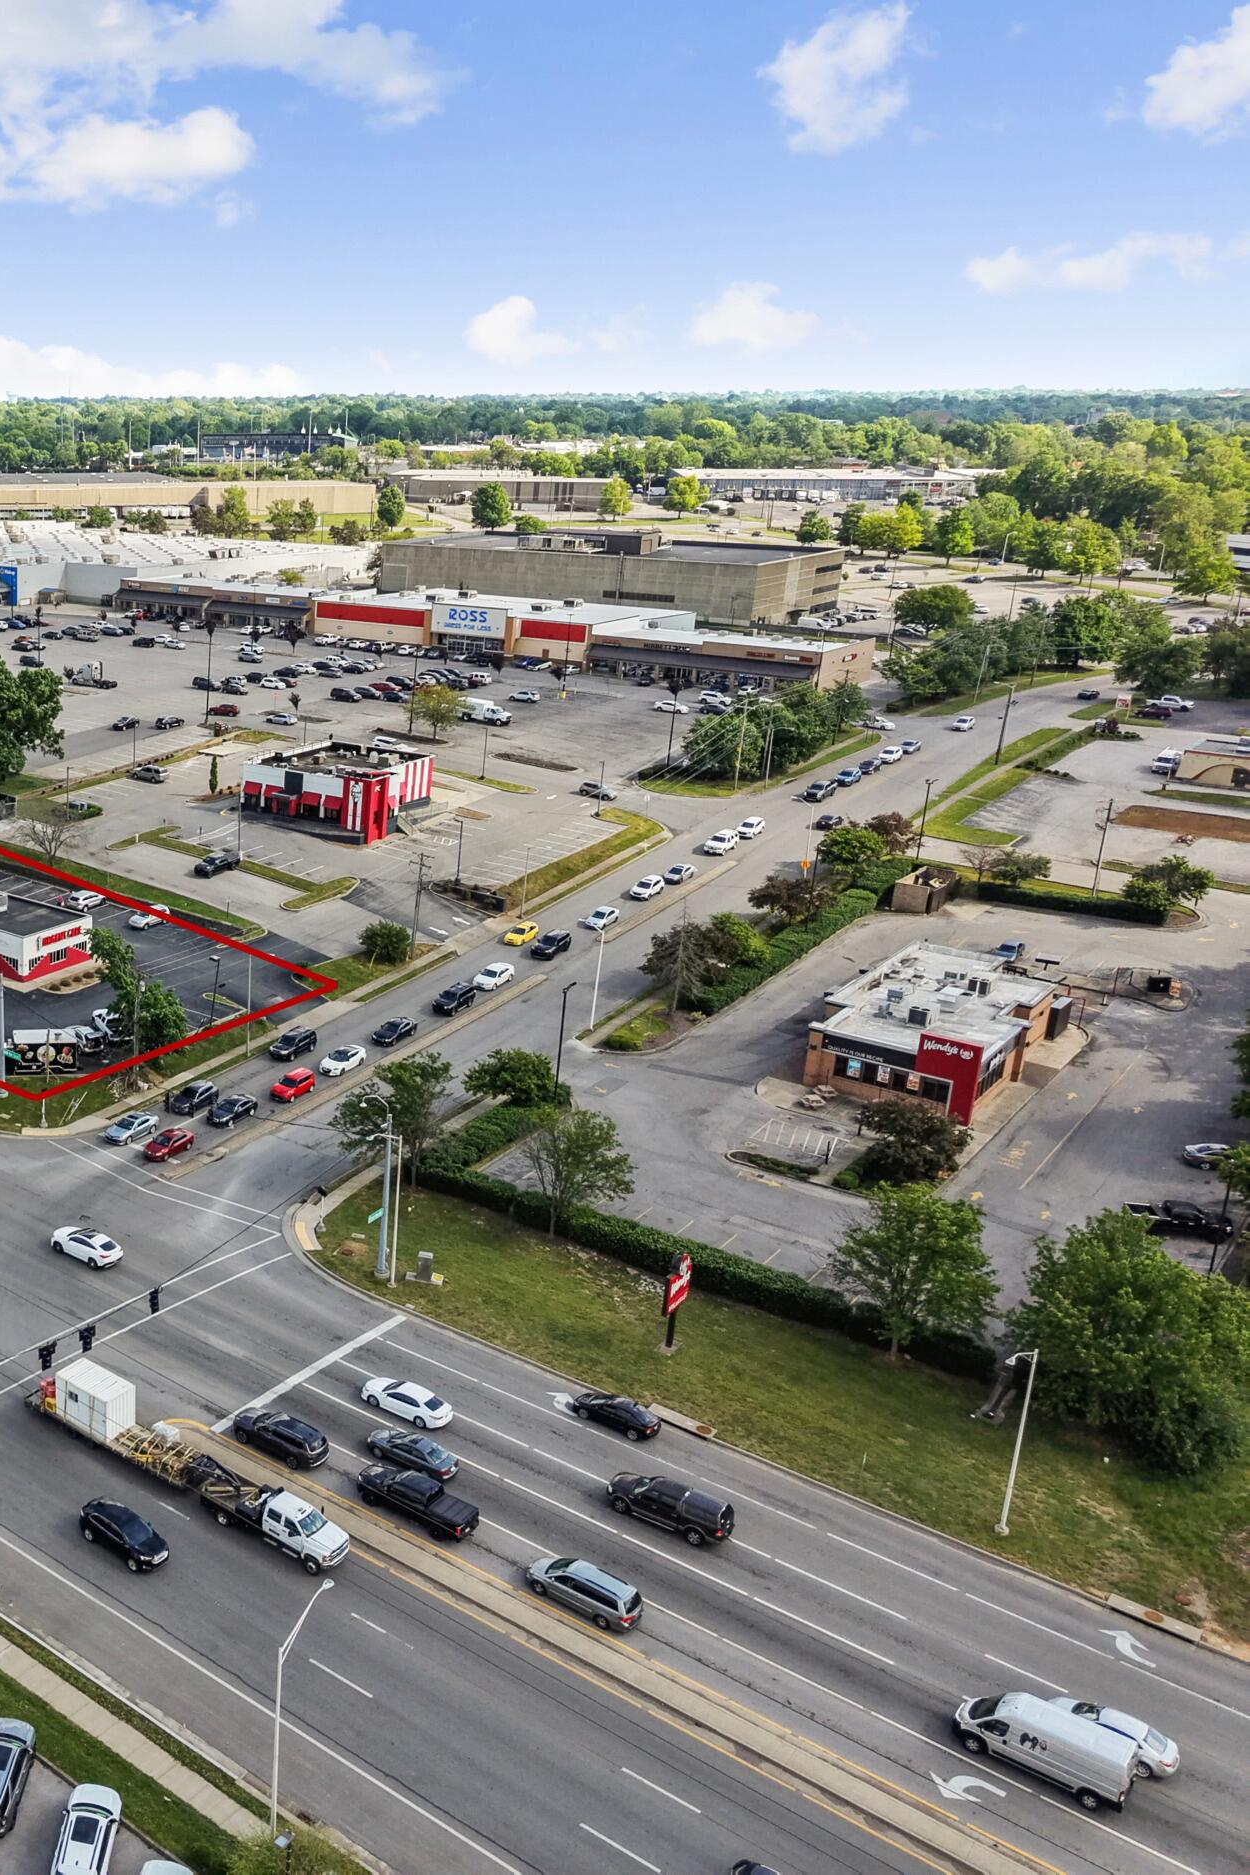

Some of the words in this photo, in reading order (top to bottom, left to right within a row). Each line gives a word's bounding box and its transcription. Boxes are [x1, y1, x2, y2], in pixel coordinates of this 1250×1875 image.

[449, 608, 488, 623] ROSS
[827, 1045, 849, 1054] QUALITY
[923, 1039, 959, 1056] Wendy's
